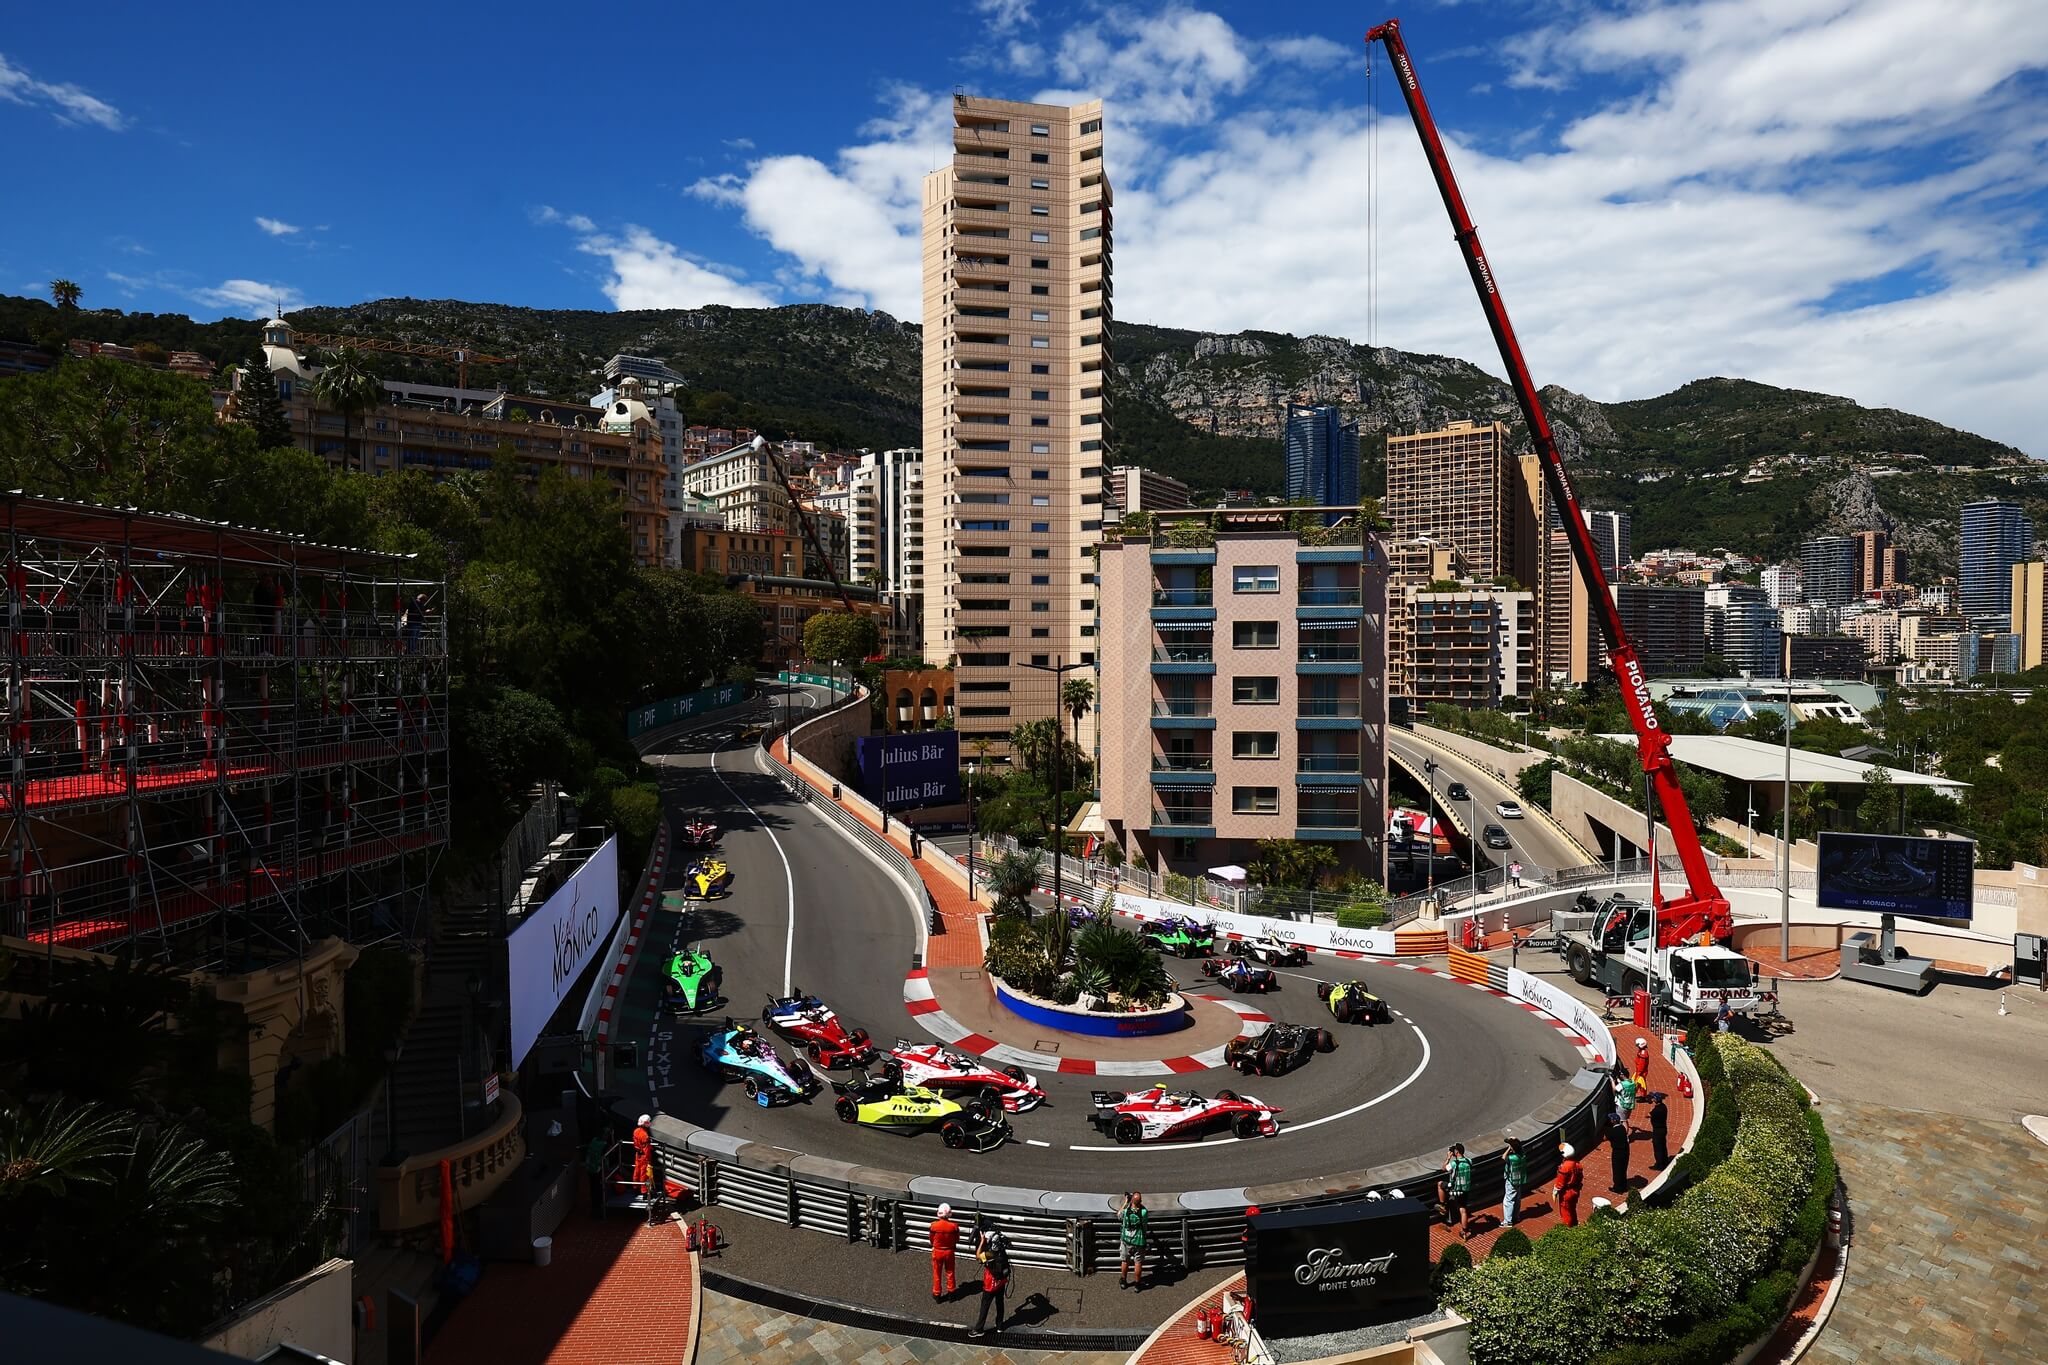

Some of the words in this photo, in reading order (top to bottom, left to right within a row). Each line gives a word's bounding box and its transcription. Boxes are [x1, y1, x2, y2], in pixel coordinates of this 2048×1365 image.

[1397, 53, 1417, 90] PIOVANO
[1475, 256, 1495, 294] PIOVANO
[1553, 462, 1573, 500] PIOVANO
[680, 697, 694, 714] PIF
[720, 688, 732, 704] PIF
[1625, 660, 1658, 729] PIOVANO
[644, 708, 656, 727] PIF
[880, 747, 918, 768] Julius
[921, 744, 945, 760] Bär
[886, 785, 920, 803] ulius
[923, 781, 946, 798] Bär
[1862, 899, 1896, 908] MONACO
[1261, 929, 1296, 941] MONACO
[1329, 937, 1374, 949] MONACO
[553, 906, 599, 998] MONACO
[1522, 987, 1553, 1010] MONACO
[1700, 989, 1751, 999] PIOVANO
[1573, 1015, 1596, 1042] MONACO
[1294, 1247, 1398, 1285] Fairmont
[1318, 1280, 1348, 1292] MONTE
[1350, 1276, 1376, 1289] CARLO
